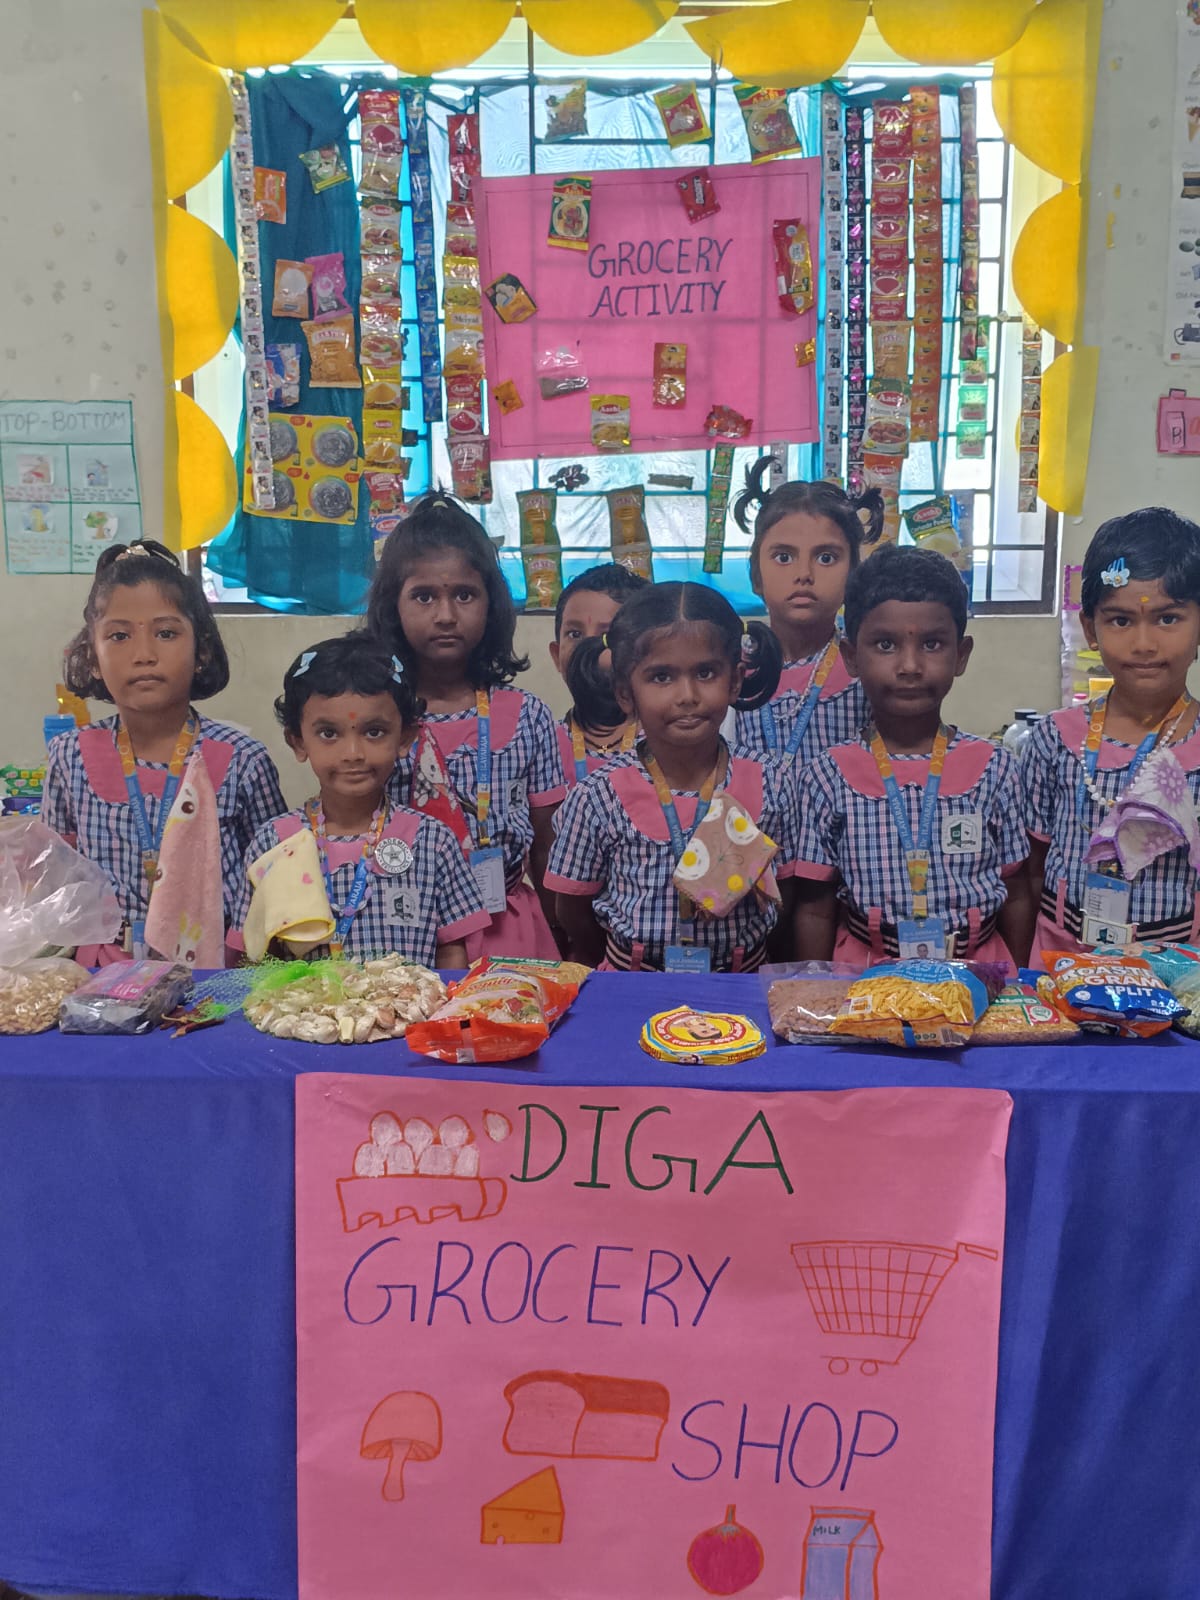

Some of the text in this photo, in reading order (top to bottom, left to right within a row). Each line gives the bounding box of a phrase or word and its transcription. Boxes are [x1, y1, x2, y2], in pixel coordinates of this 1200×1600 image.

[588, 237, 733, 278] GROCERY
[589, 280, 727, 318] ACTIVITY
[921, 794, 935, 836] ILAYARAJA
[1084, 975, 1164, 989] GRAM
[1104, 986, 1153, 997] SPLIT
[510, 1103, 796, 1195] DIGA
[344, 1236, 731, 1327] GROCERY
[672, 1400, 899, 1491] SHOP
[813, 1525, 841, 1537] MILK
